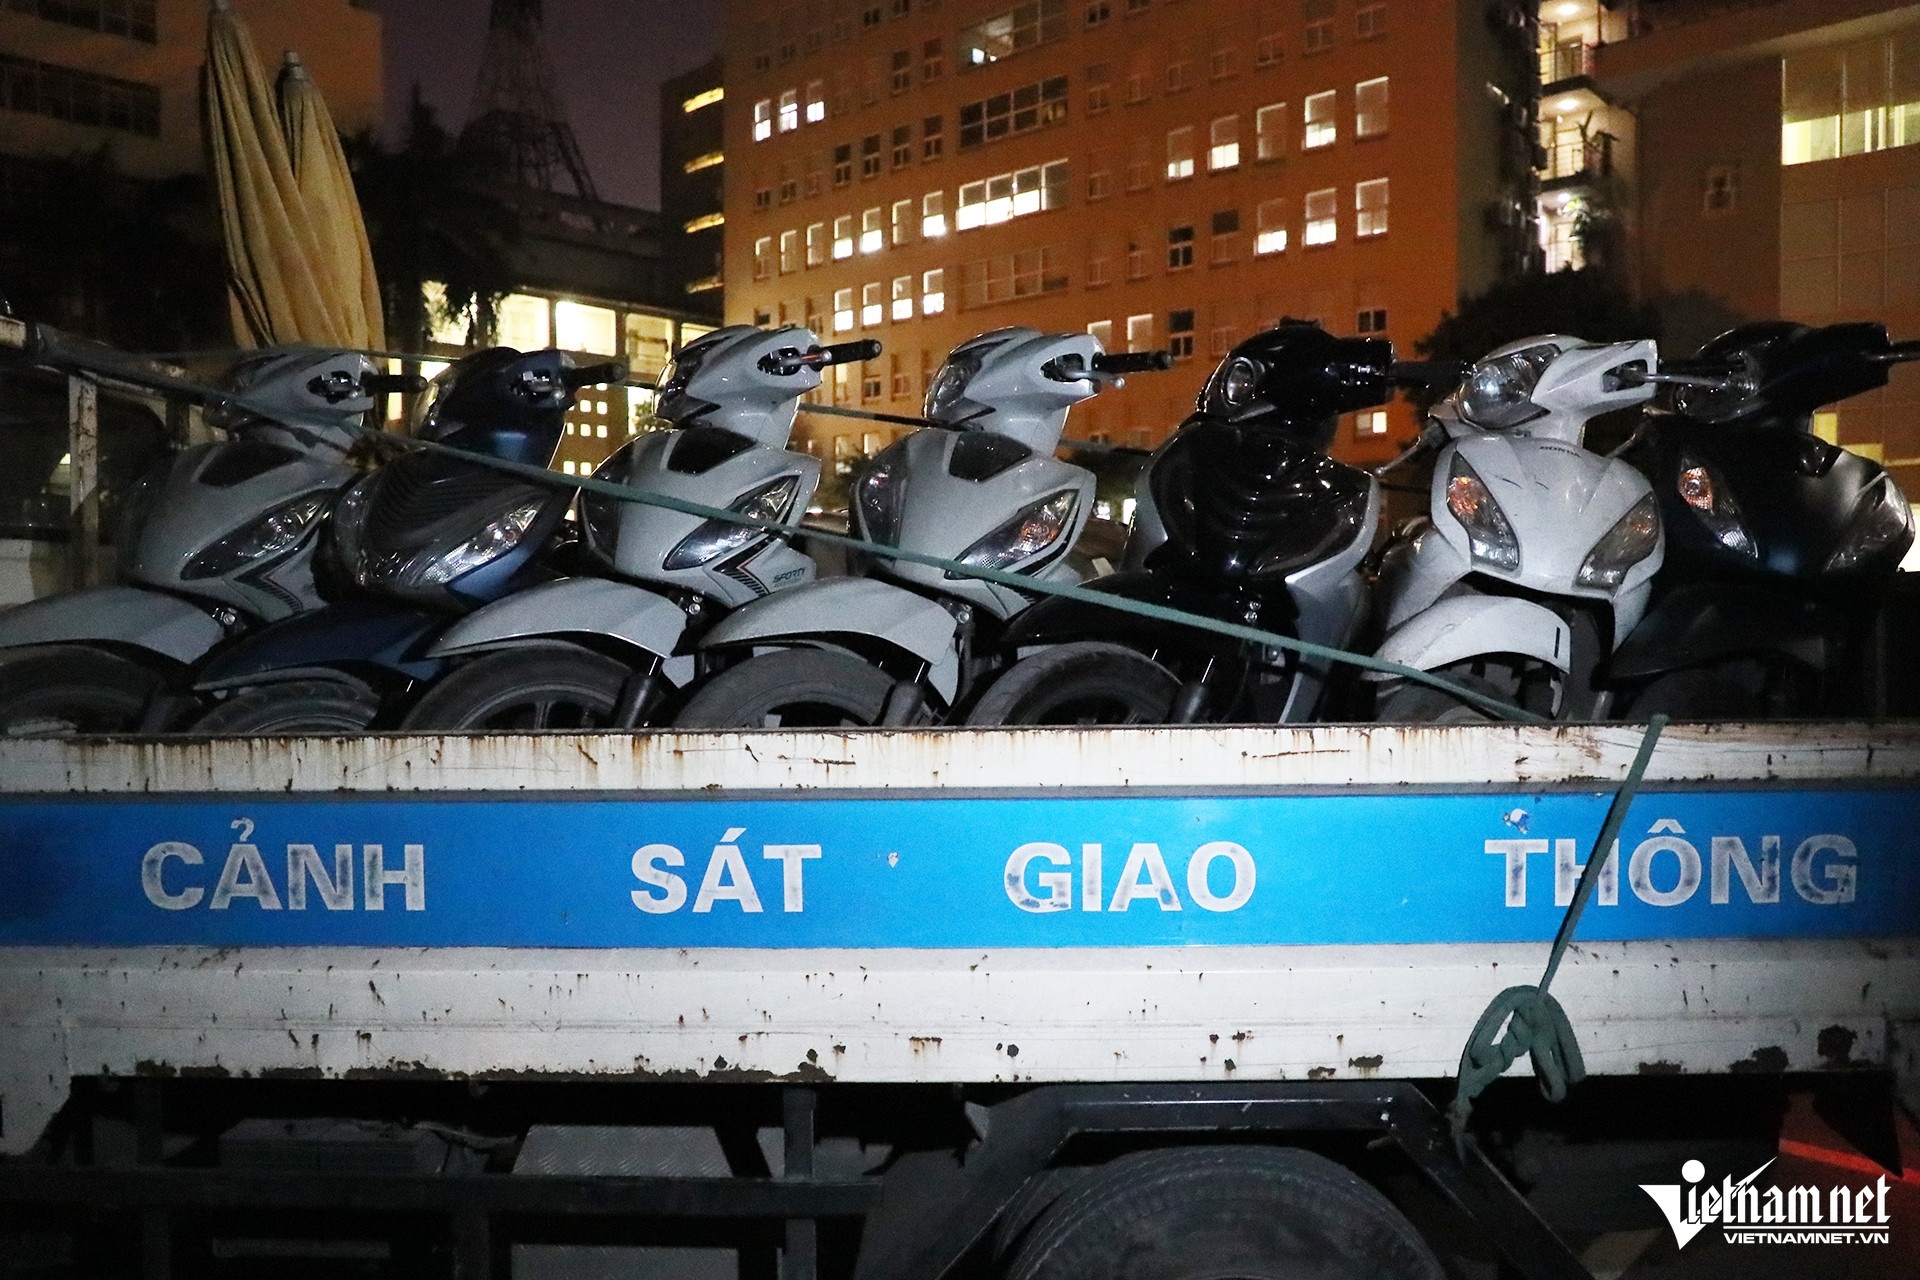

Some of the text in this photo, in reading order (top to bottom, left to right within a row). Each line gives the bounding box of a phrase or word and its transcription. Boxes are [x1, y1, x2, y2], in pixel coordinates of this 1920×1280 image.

[141, 817, 1858, 914] CẢNH SÁT GIAO THÔNG
